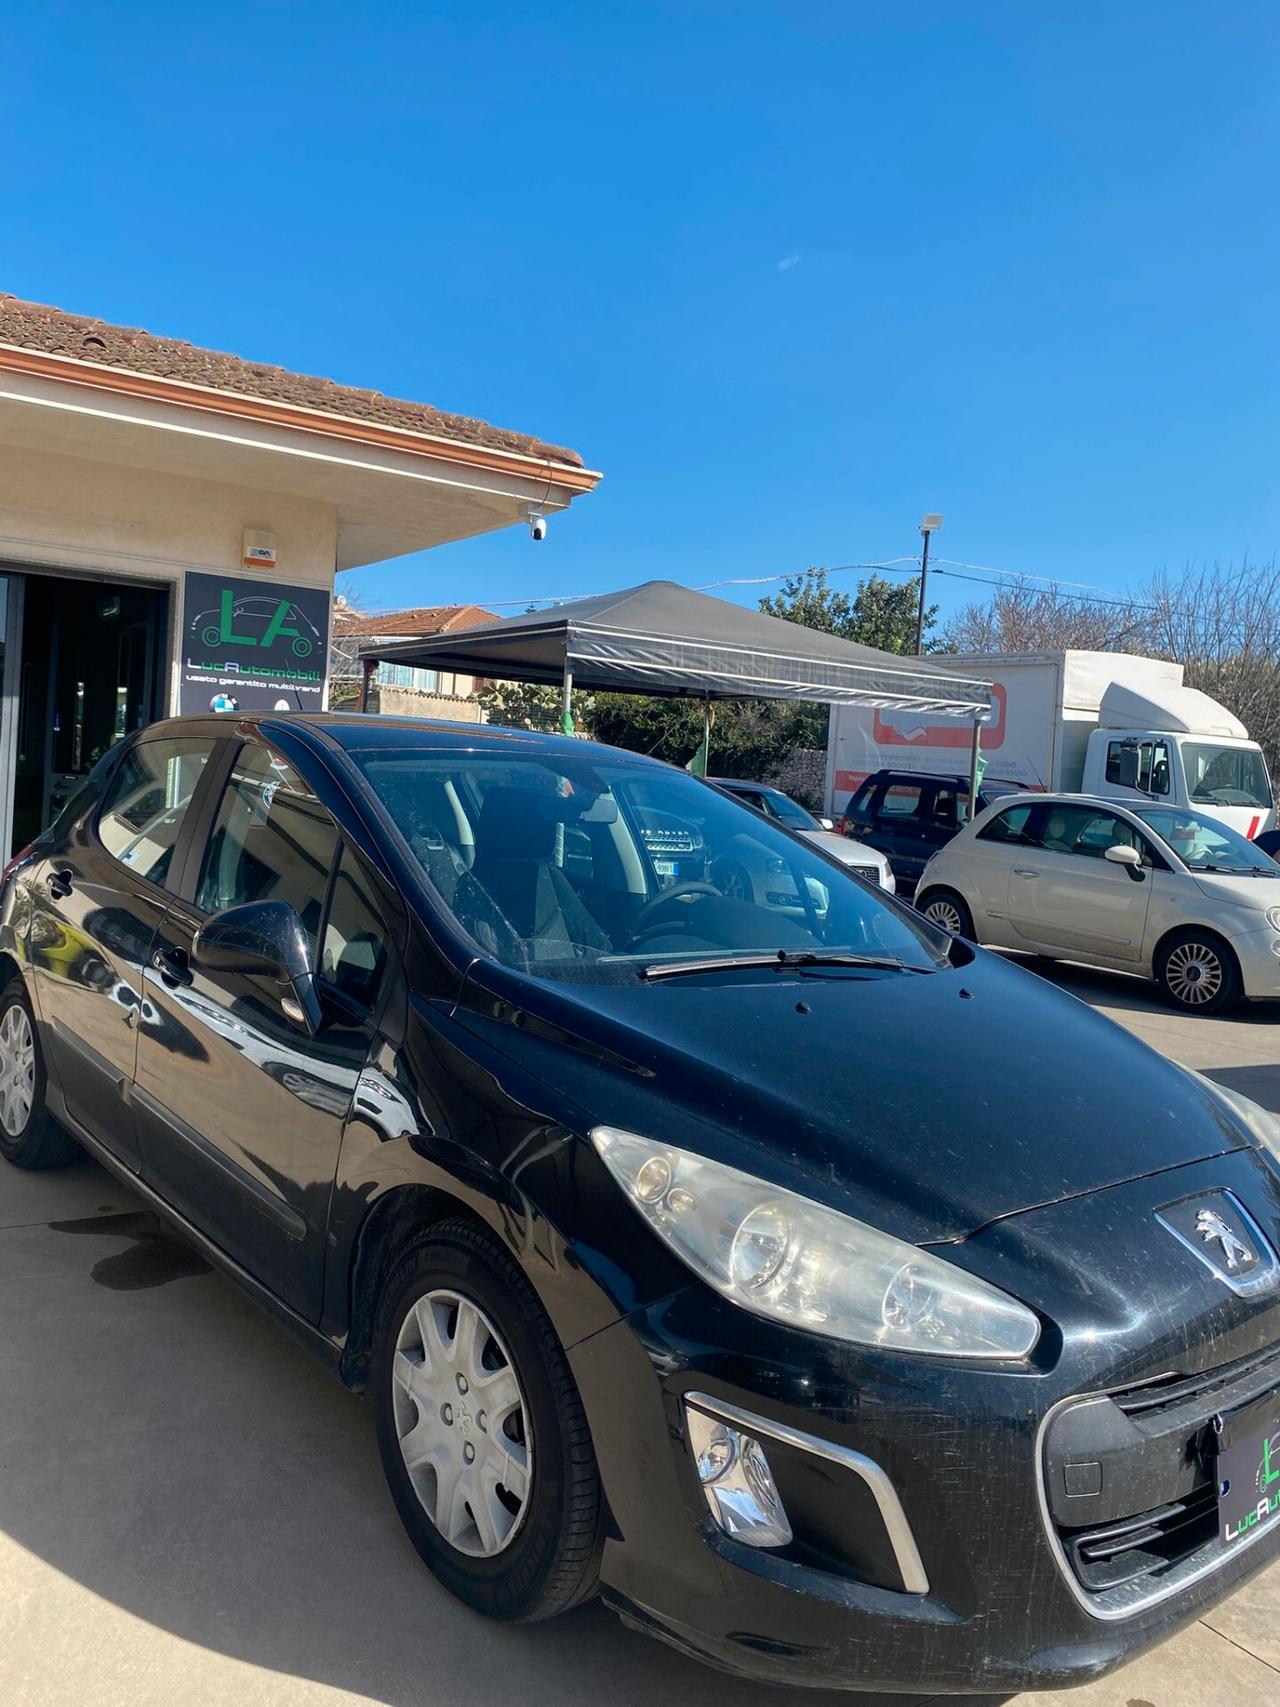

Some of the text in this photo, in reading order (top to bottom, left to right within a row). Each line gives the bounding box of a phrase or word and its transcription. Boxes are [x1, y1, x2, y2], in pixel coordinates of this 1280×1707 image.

[187, 658, 321, 681] LucAutomobili
[185, 674, 321, 693] usato garantito multibrand
